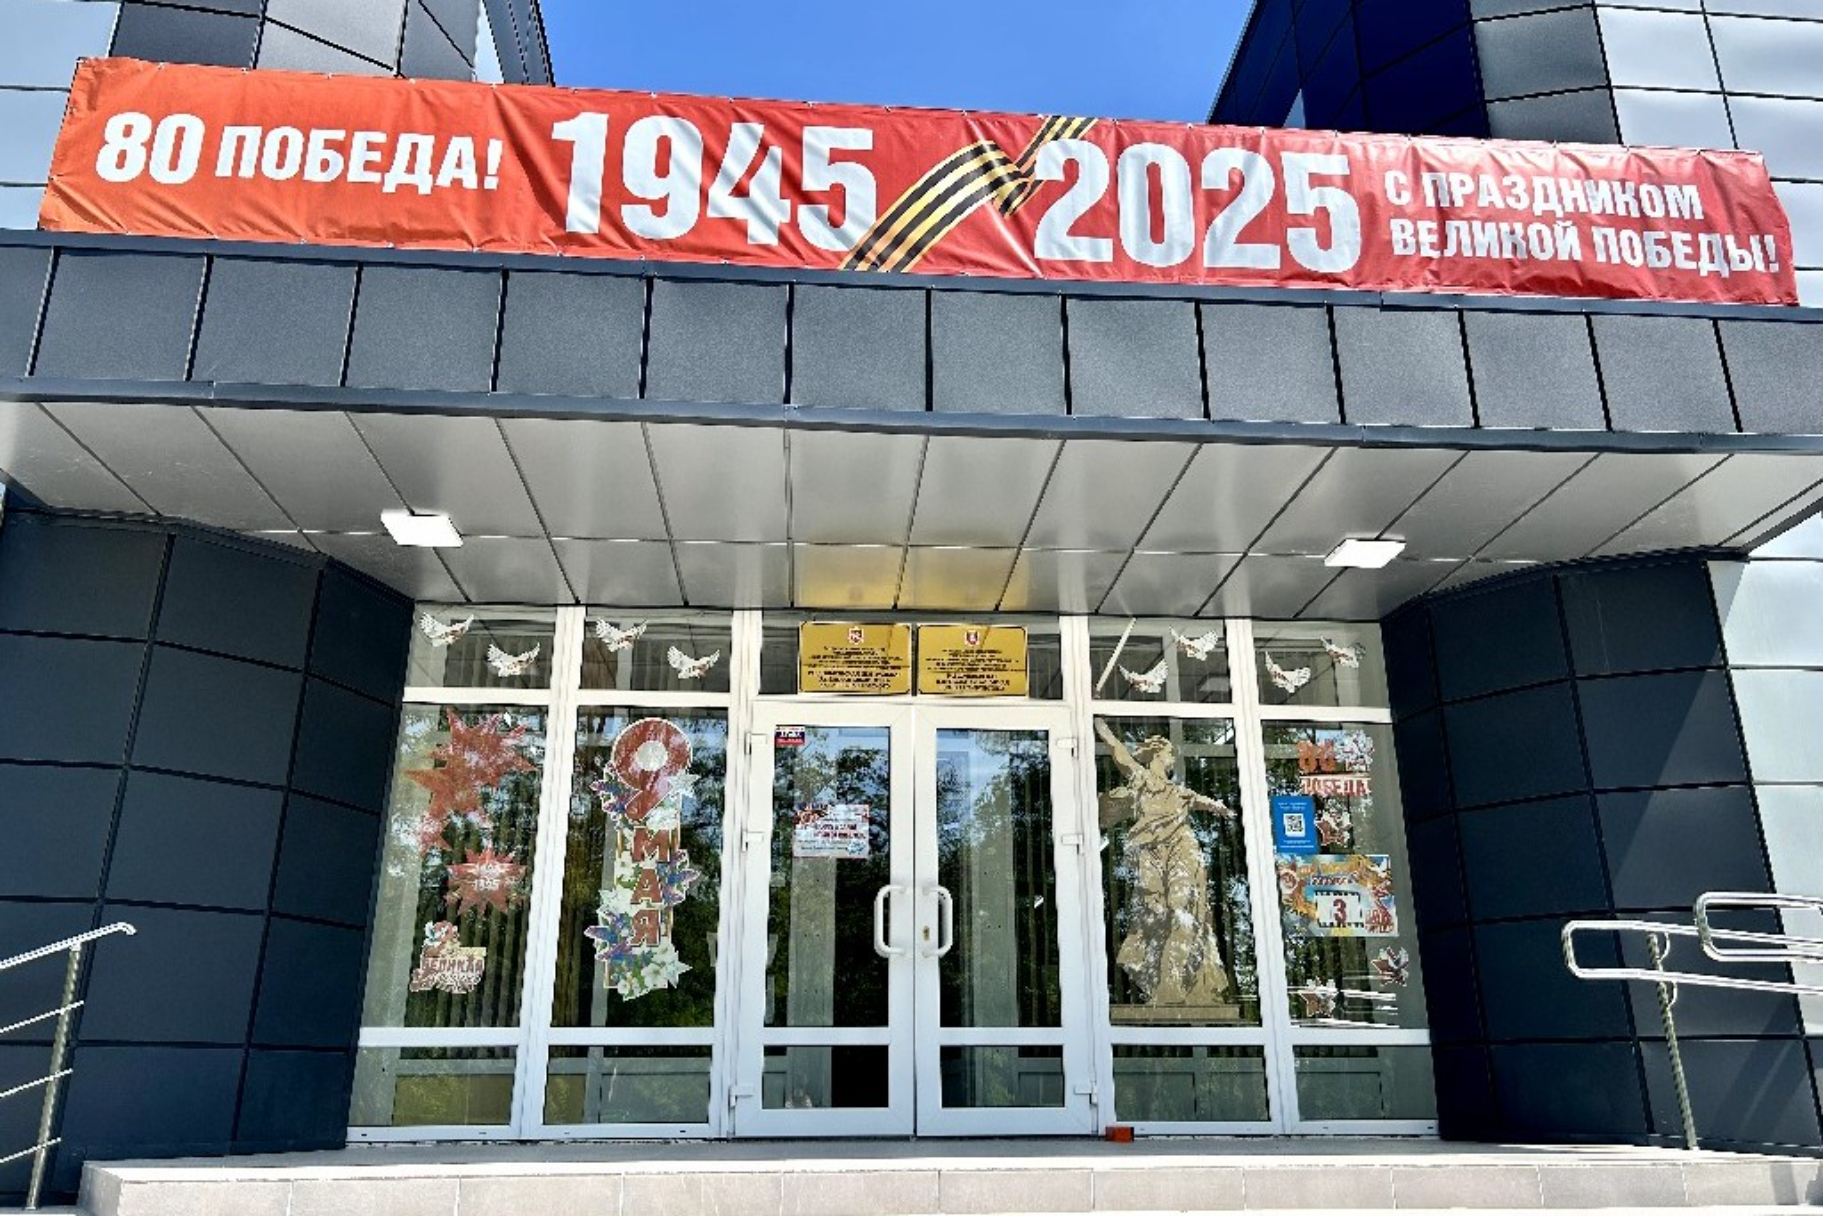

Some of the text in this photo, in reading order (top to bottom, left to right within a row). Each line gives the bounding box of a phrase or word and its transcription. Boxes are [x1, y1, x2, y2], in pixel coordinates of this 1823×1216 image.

[96, 111, 503, 195] 80 ПОБЕДА!
[552, 111, 1362, 273] 1945 2025
[1384, 170, 1704, 220] С ПРАЗДНИКОМ
[1390, 218, 1780, 278] ВЕЛИКОЙ ПОБЕДЫ!
